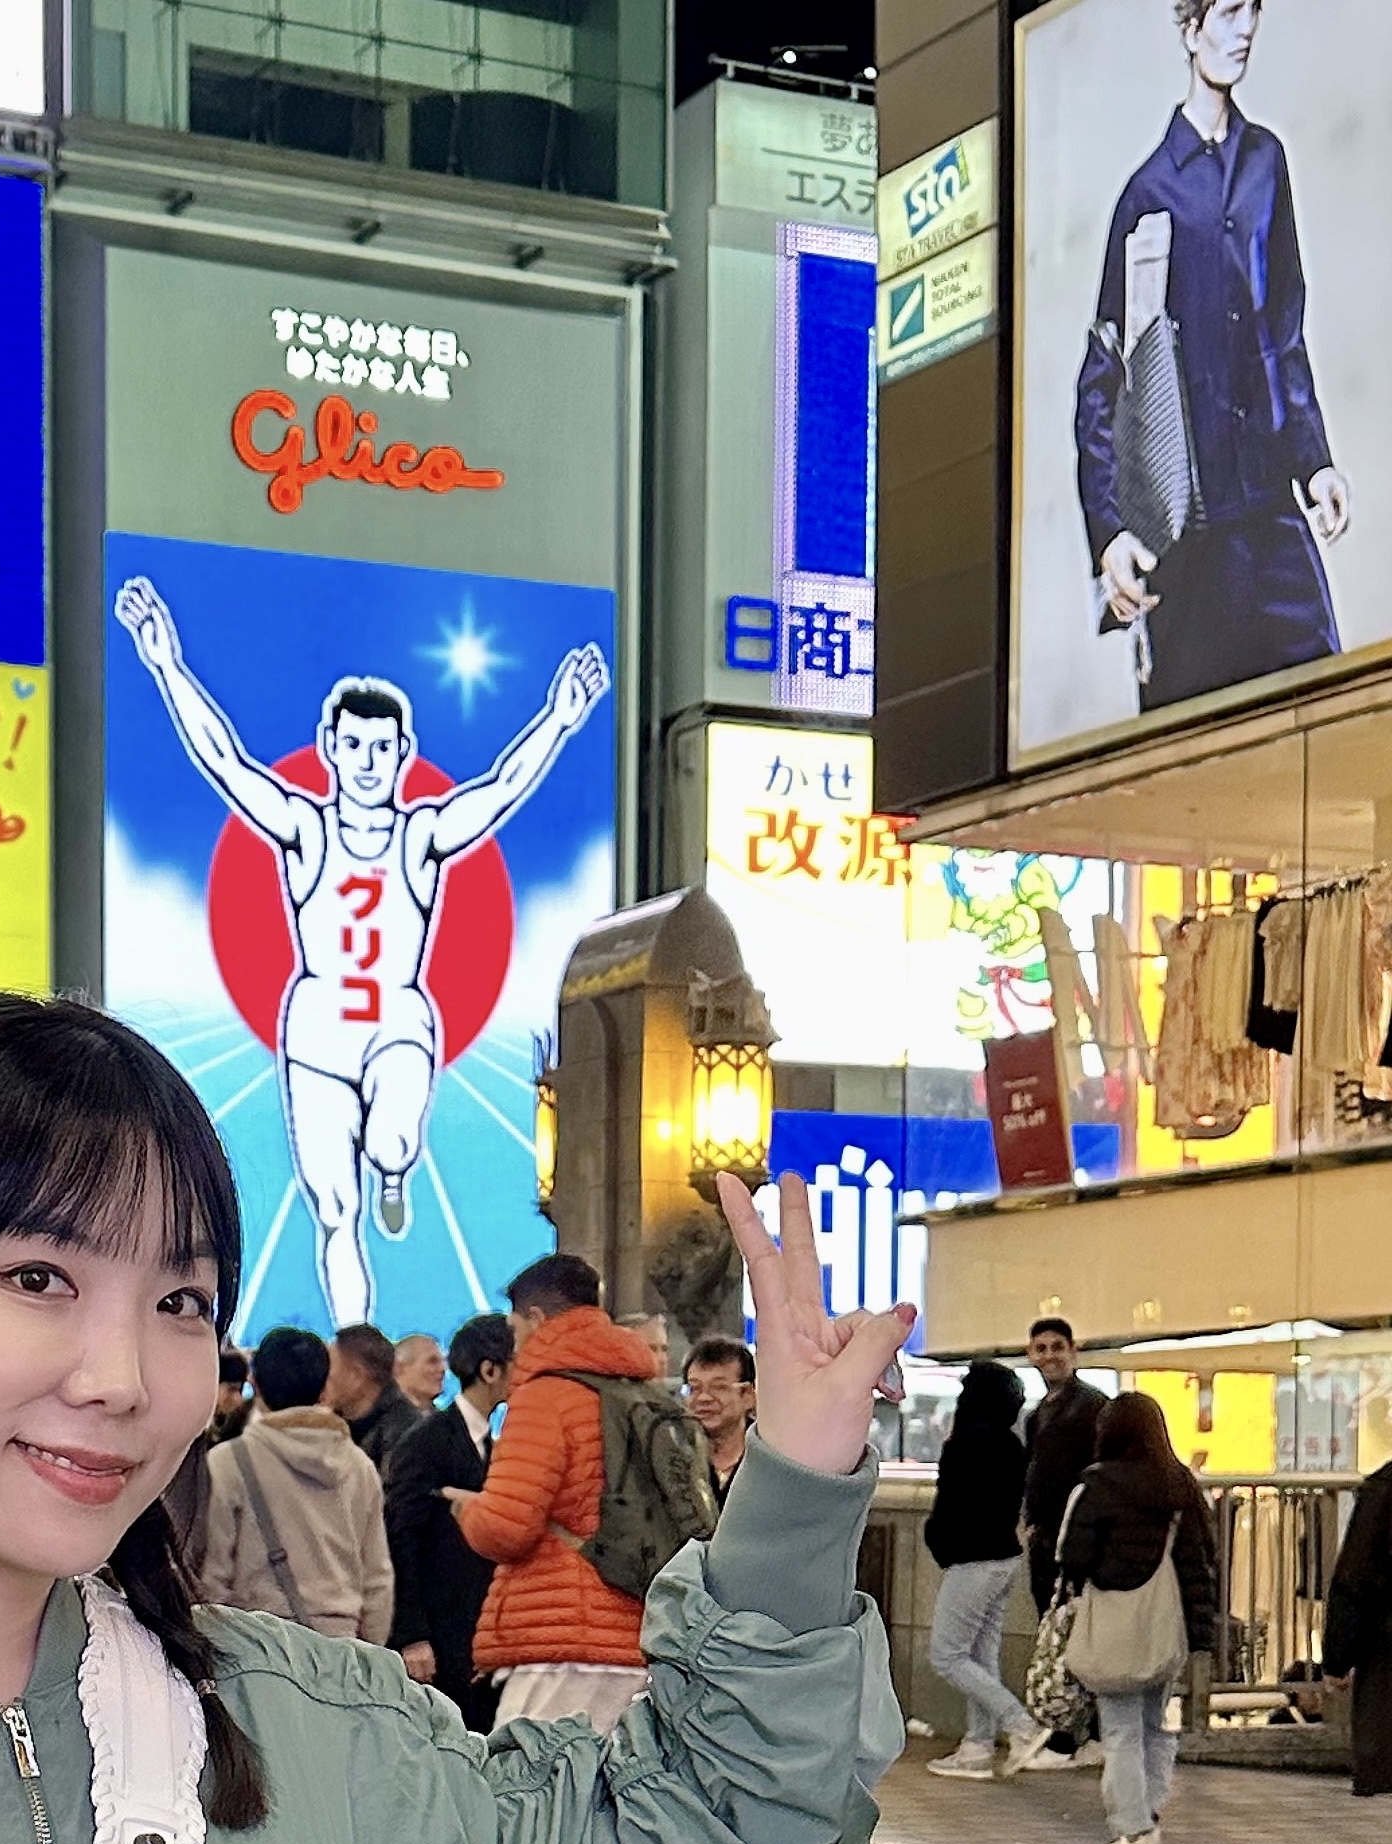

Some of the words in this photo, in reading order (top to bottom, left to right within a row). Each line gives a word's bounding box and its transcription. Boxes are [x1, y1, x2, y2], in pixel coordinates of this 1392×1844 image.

[271, 307, 470, 369] すこやかな毎日、
[286, 345, 451, 400] ゆたかな人生
[232, 388, 504, 514] Glico
[746, 808, 919, 886] 改源
